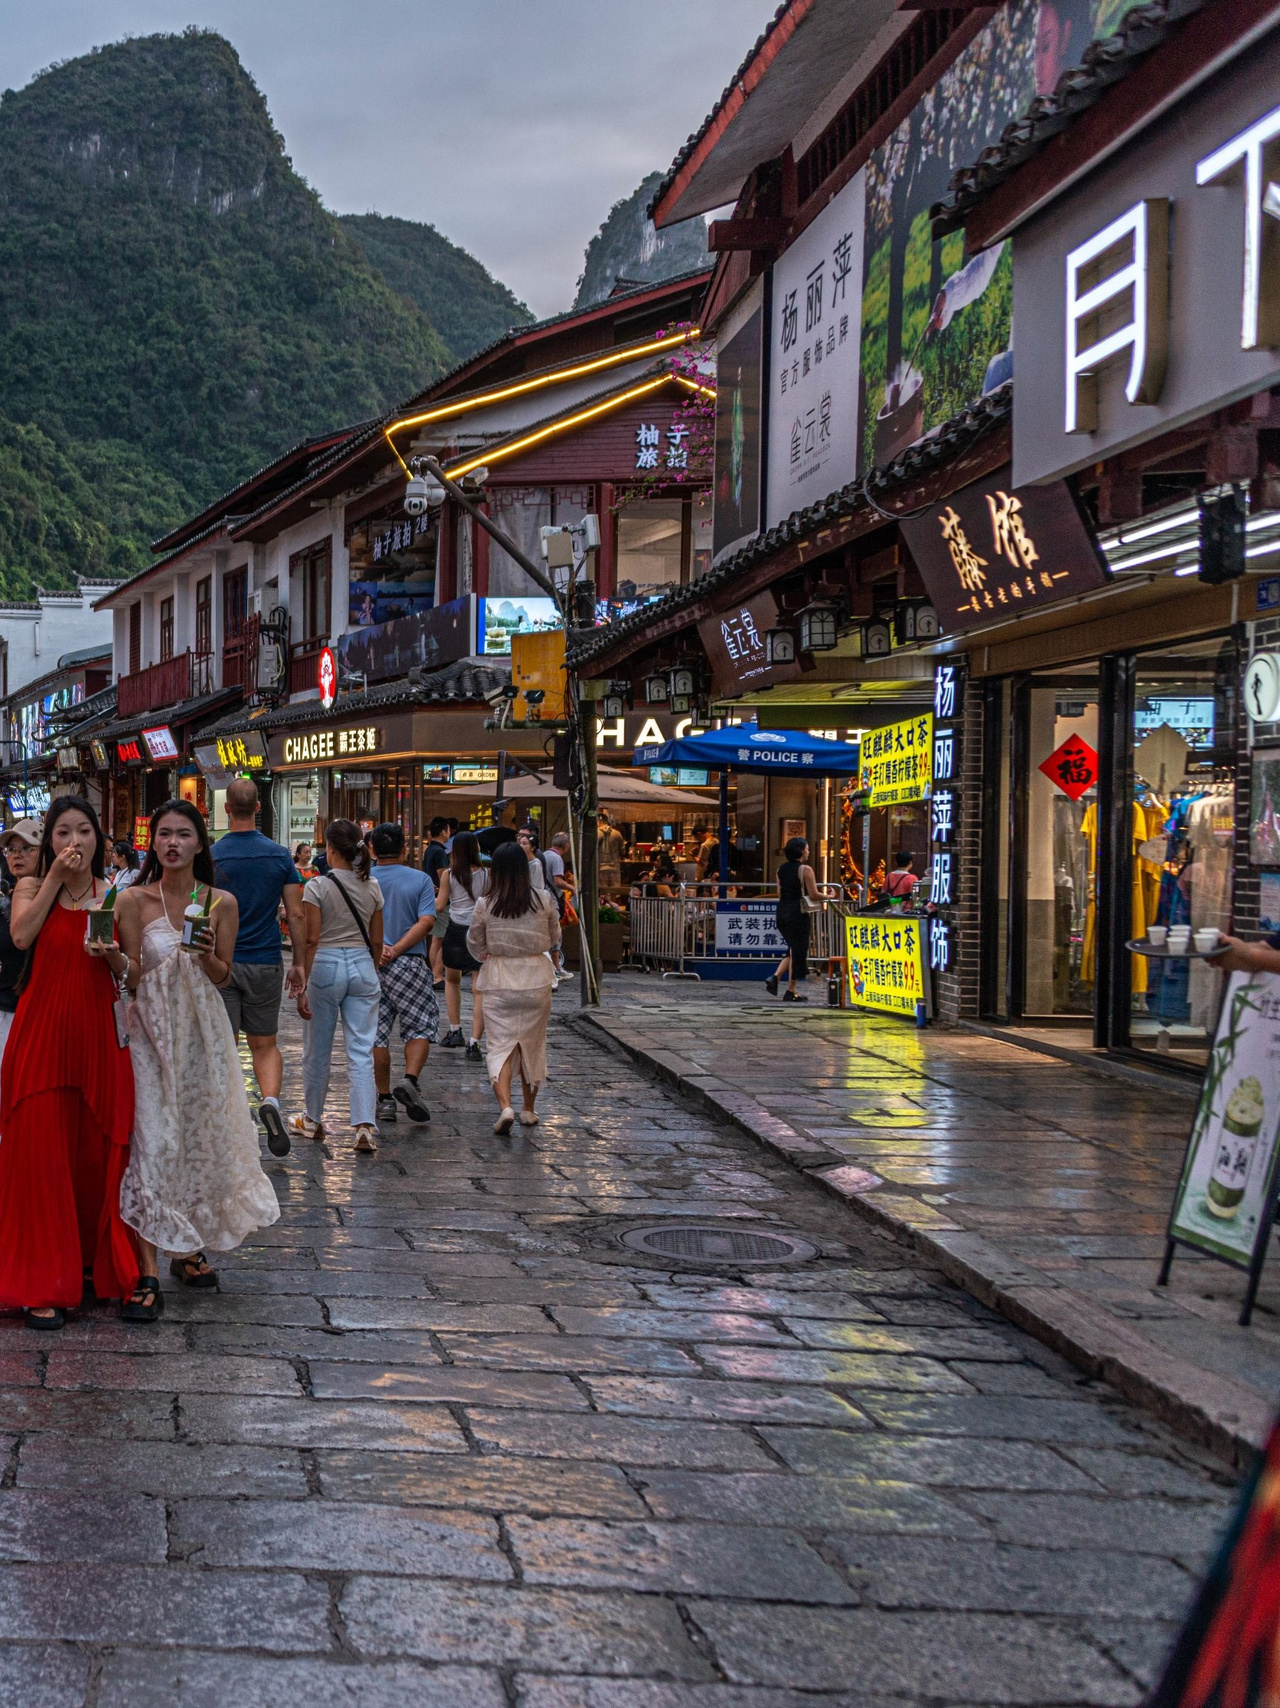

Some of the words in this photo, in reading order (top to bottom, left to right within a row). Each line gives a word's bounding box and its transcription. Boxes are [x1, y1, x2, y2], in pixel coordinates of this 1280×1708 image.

[780, 231, 853, 354] 杨丽萍
[780, 314, 849, 396] 官方服饰品牌
[636, 423, 689, 446] 柚子
[636, 447, 688, 470] 旅拍
[373, 522, 412, 562] 柚子旅拍
[285, 732, 334, 763] CHAGEE
[339, 727, 376, 753] 霸王茶姬
[738, 748, 750, 761] 警
[753, 750, 799, 763] POLICE
[801, 752, 814, 765] 察
[1056, 749, 1093, 785] 福
[930, 666, 956, 972] 杨丽萍服饰
